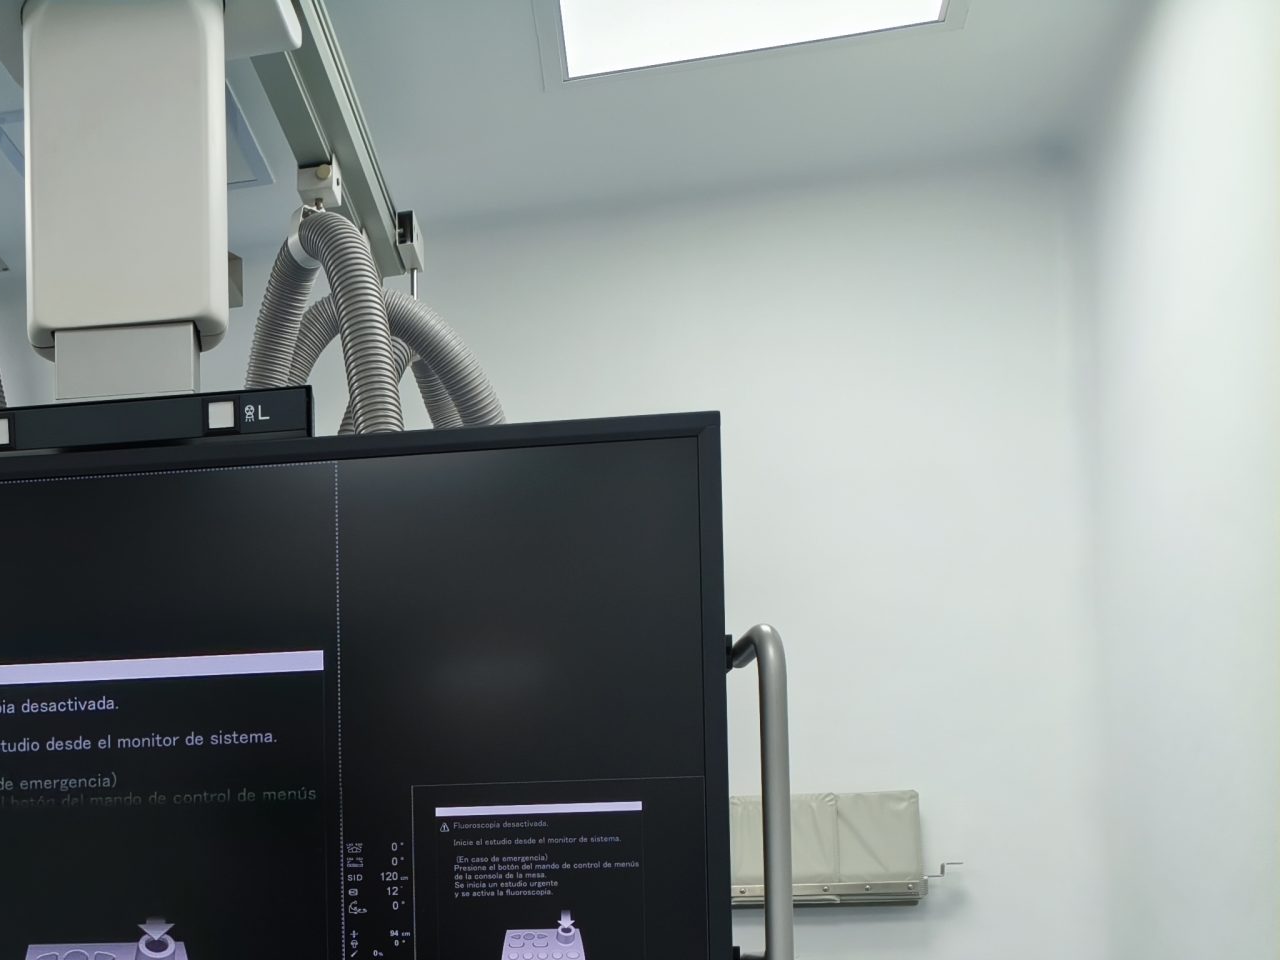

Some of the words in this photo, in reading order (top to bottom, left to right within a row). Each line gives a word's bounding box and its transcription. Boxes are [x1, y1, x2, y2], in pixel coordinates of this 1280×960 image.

[258, 404, 270, 420] L
[21, 696, 119, 713] desactivada.
[46, 736, 91, 751] desde
[98, 735, 111, 749] el
[117, 732, 179, 749] monitor
[185, 731, 204, 746] de
[210, 730, 277, 746] sistema.
[20, 771, 117, 791] emergencia)
[173, 788, 230, 804] control
[237, 788, 256, 802] de
[263, 786, 317, 801] menús
[475, 838, 483, 846] el
[514, 836, 536, 845] desde
[538, 836, 545, 844] el
[547, 836, 576, 844] monitor
[490, 855, 500, 863] de
[489, 864, 496, 872] el
[521, 862, 533, 871] del
[534, 862, 560, 870] mando
[573, 861, 601, 869] control
[380, 872, 398, 881] 120
[454, 872, 464, 880] de
[465, 872, 472, 880] la
[474, 871, 503, 880] consola
[504, 871, 514, 879] de
[516, 871, 523, 879] la
[500, 880, 527, 888] estudio
[496, 889, 503, 897] la
